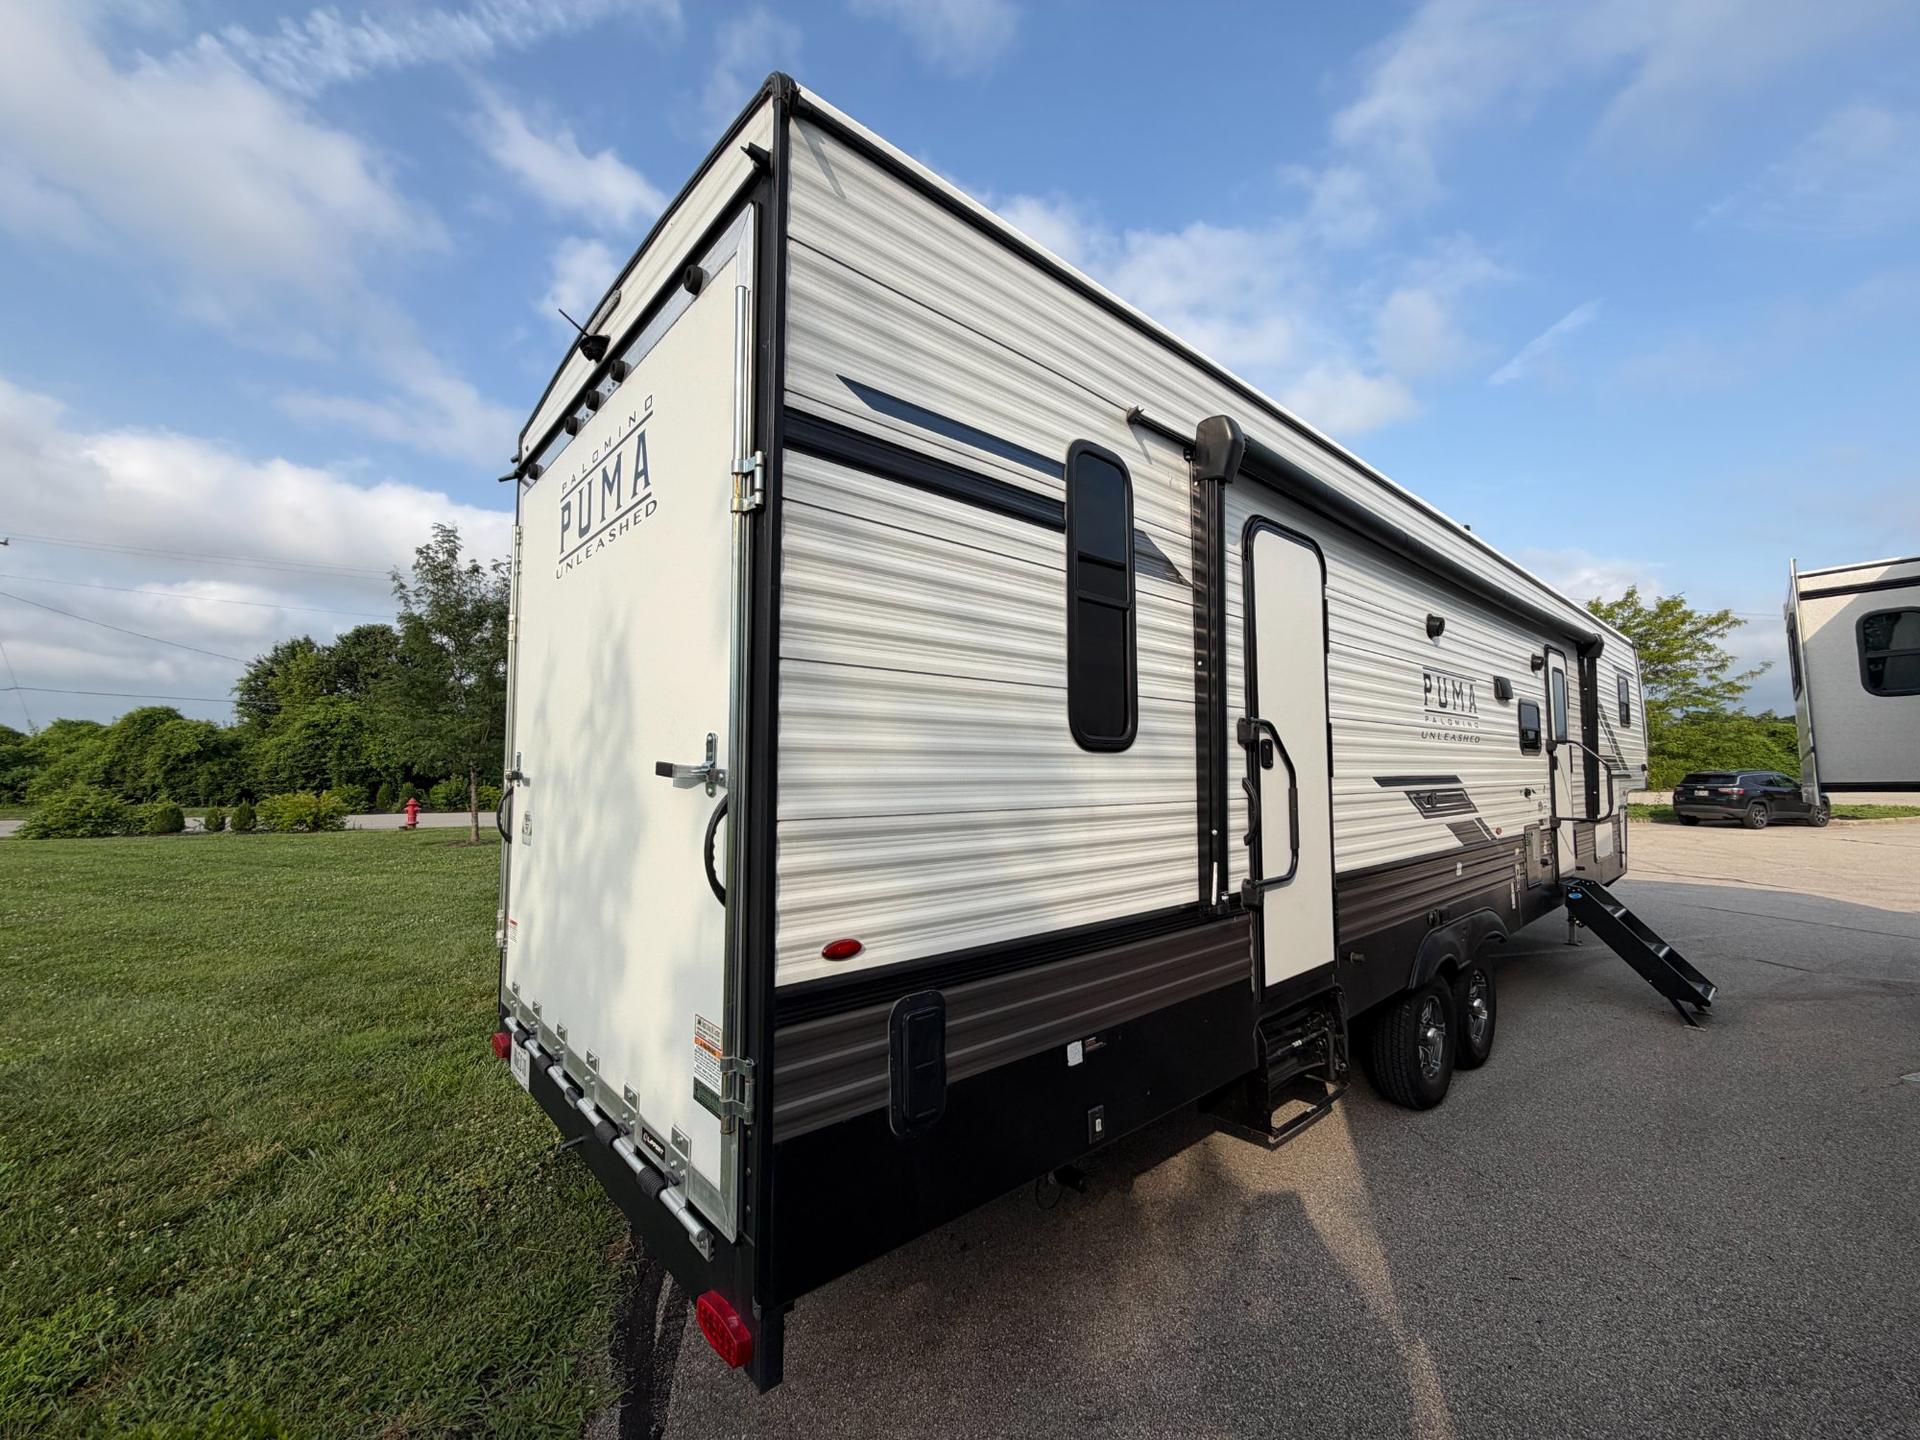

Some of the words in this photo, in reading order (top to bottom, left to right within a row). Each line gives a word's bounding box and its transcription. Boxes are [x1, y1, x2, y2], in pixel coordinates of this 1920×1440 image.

[561, 394, 653, 494] PALOMINO
[559, 429, 651, 555] PUMA
[556, 499, 658, 580] UNLEASHED
[1423, 672, 1477, 713] PUMA
[1421, 731, 1480, 743] UNLEASHED
